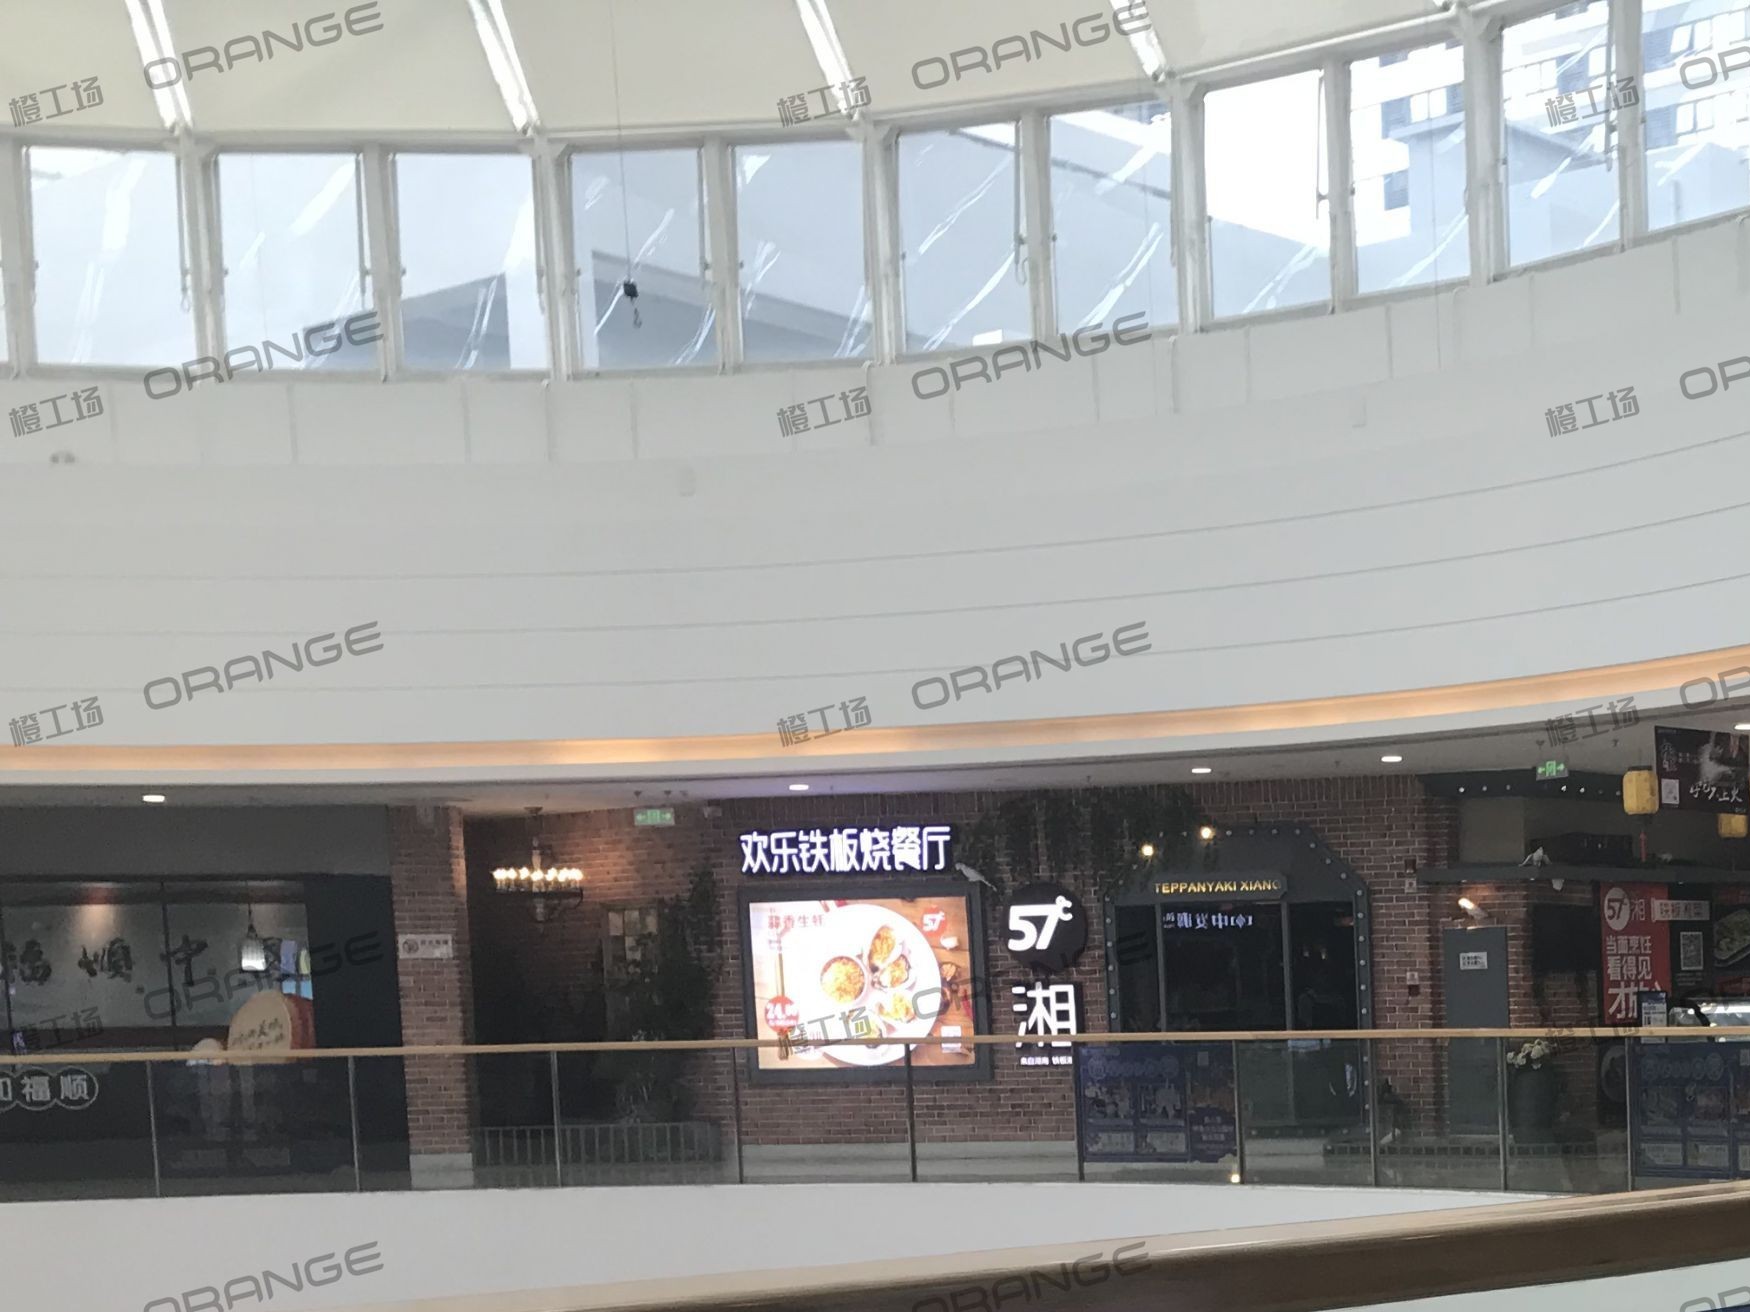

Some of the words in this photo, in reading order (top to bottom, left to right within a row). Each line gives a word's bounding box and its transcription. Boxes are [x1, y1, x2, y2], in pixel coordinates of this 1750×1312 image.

[740, 826, 951, 873] 欢乐铁板烧餐厅
[1155, 882, 1237, 893] TEPPANYAKI
[1607, 956, 1652, 981] 看得见
[1012, 981, 1077, 1047] 湘
